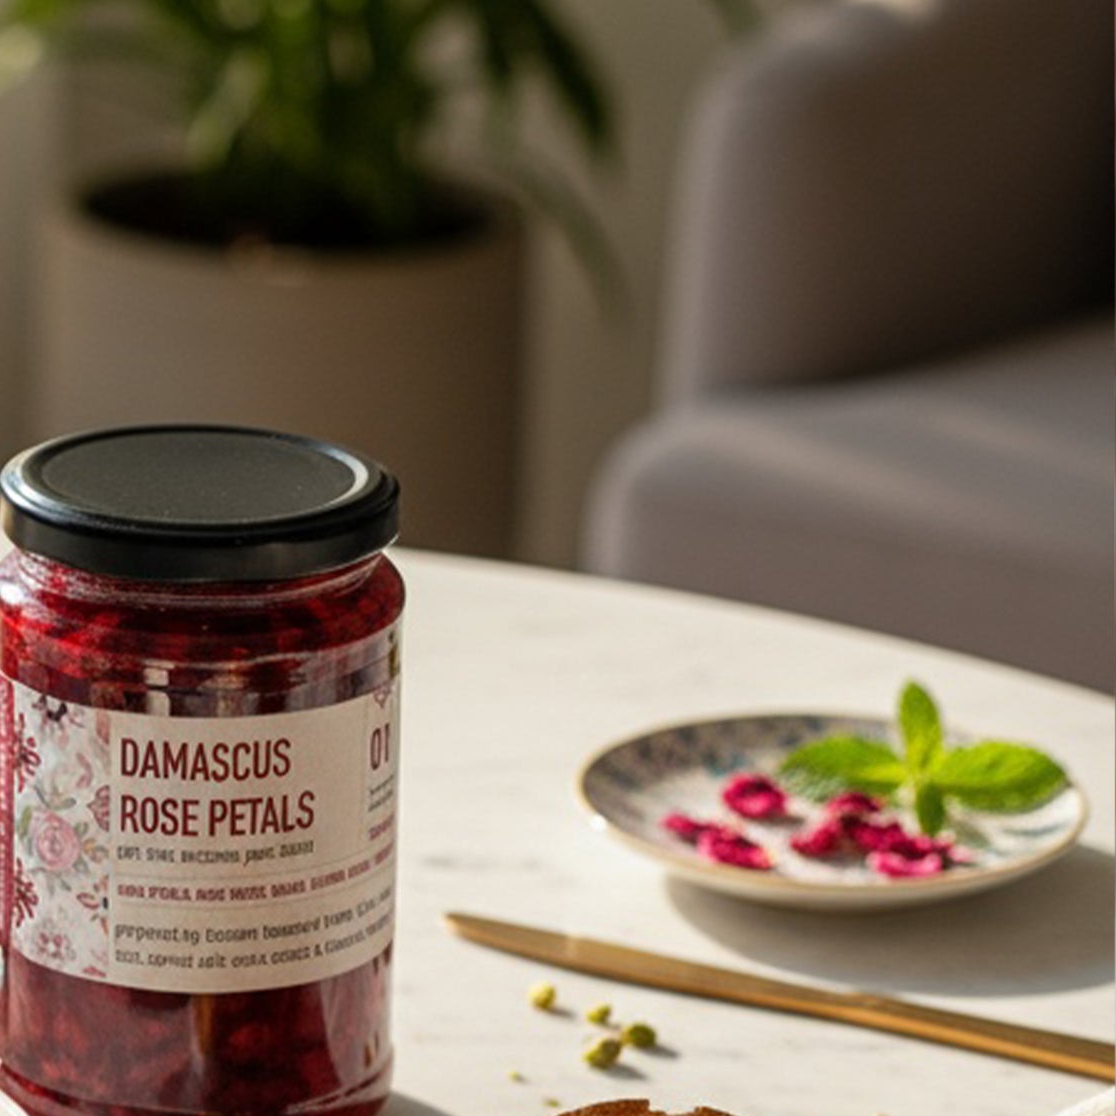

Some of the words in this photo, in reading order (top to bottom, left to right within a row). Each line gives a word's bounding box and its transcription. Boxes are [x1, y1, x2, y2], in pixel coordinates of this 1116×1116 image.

[120, 737, 292, 782] DAMASCUS
[369, 723, 390, 770] 01
[120, 794, 200, 837] ROSE
[208, 790, 315, 837] PETALS
